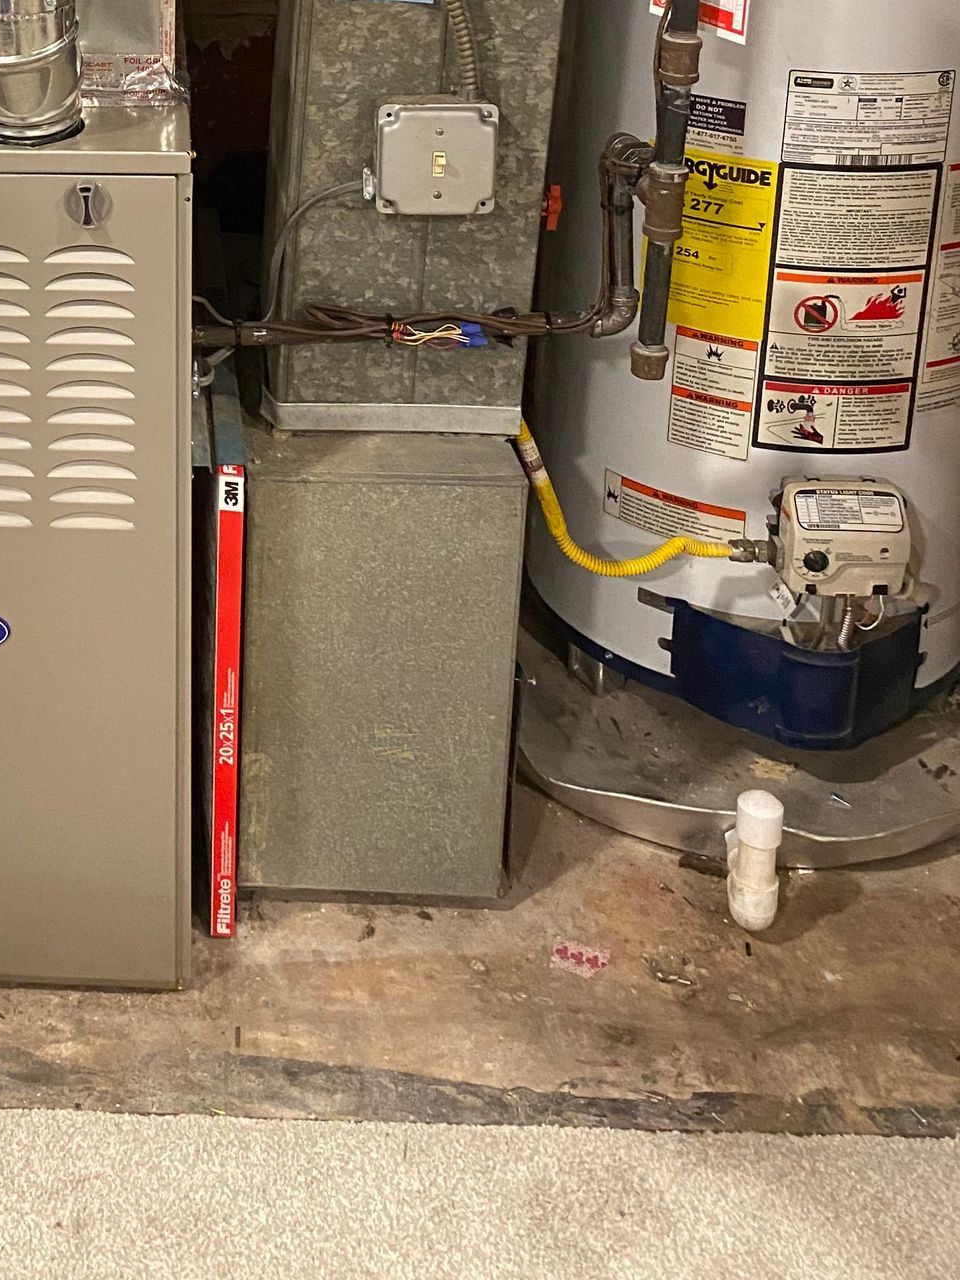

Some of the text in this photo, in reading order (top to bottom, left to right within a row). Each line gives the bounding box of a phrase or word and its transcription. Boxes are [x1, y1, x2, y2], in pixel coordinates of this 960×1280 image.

[684, 157, 772, 190] RGYGUIDE
[690, 198, 725, 215] 277
[675, 246, 700, 260] 254
[698, 332, 744, 348] WARNING
[823, 387, 869, 395] DANGER
[693, 394, 739, 409] WARNING
[224, 481, 239, 507] 3M
[219, 708, 234, 766] 20x25x1
[216, 879, 232, 934] Filtrete
